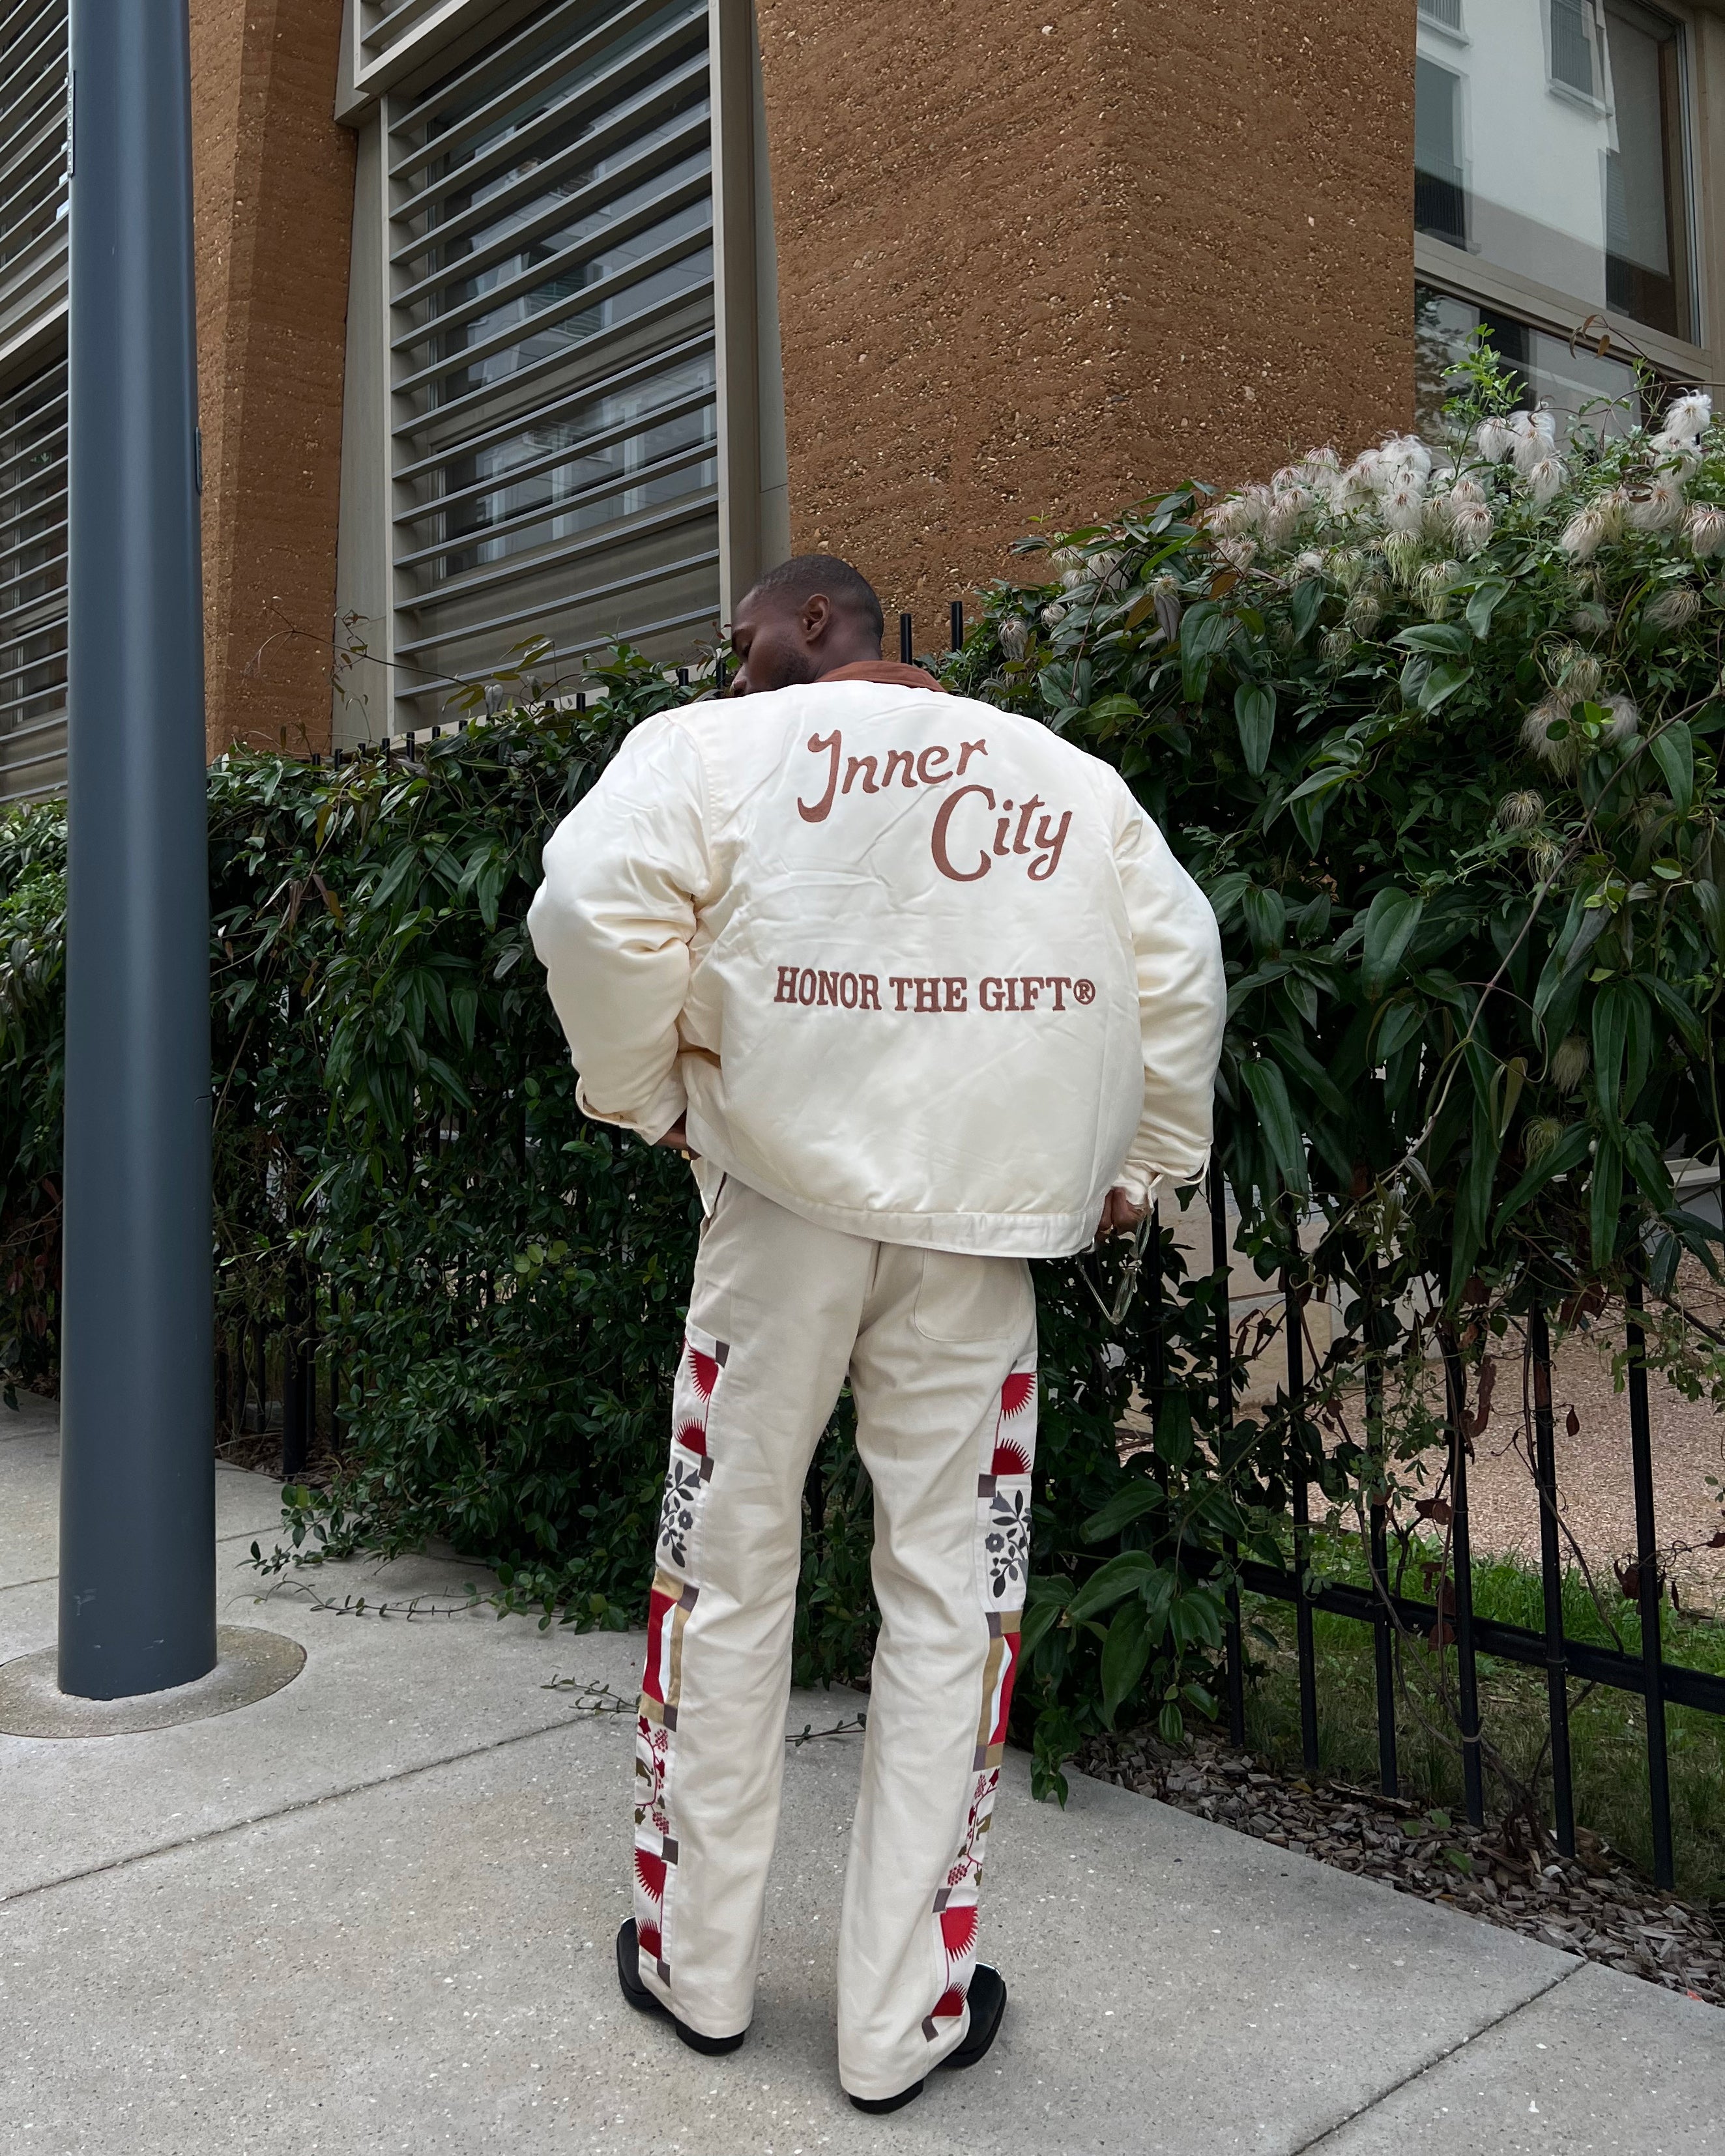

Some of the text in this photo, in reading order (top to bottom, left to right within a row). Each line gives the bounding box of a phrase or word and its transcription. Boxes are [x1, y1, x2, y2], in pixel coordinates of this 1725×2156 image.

[797, 729, 989, 823] Inner
[931, 784, 1073, 882] City
[773, 966, 882, 1011] HONOR
[889, 977, 968, 1013] THE
